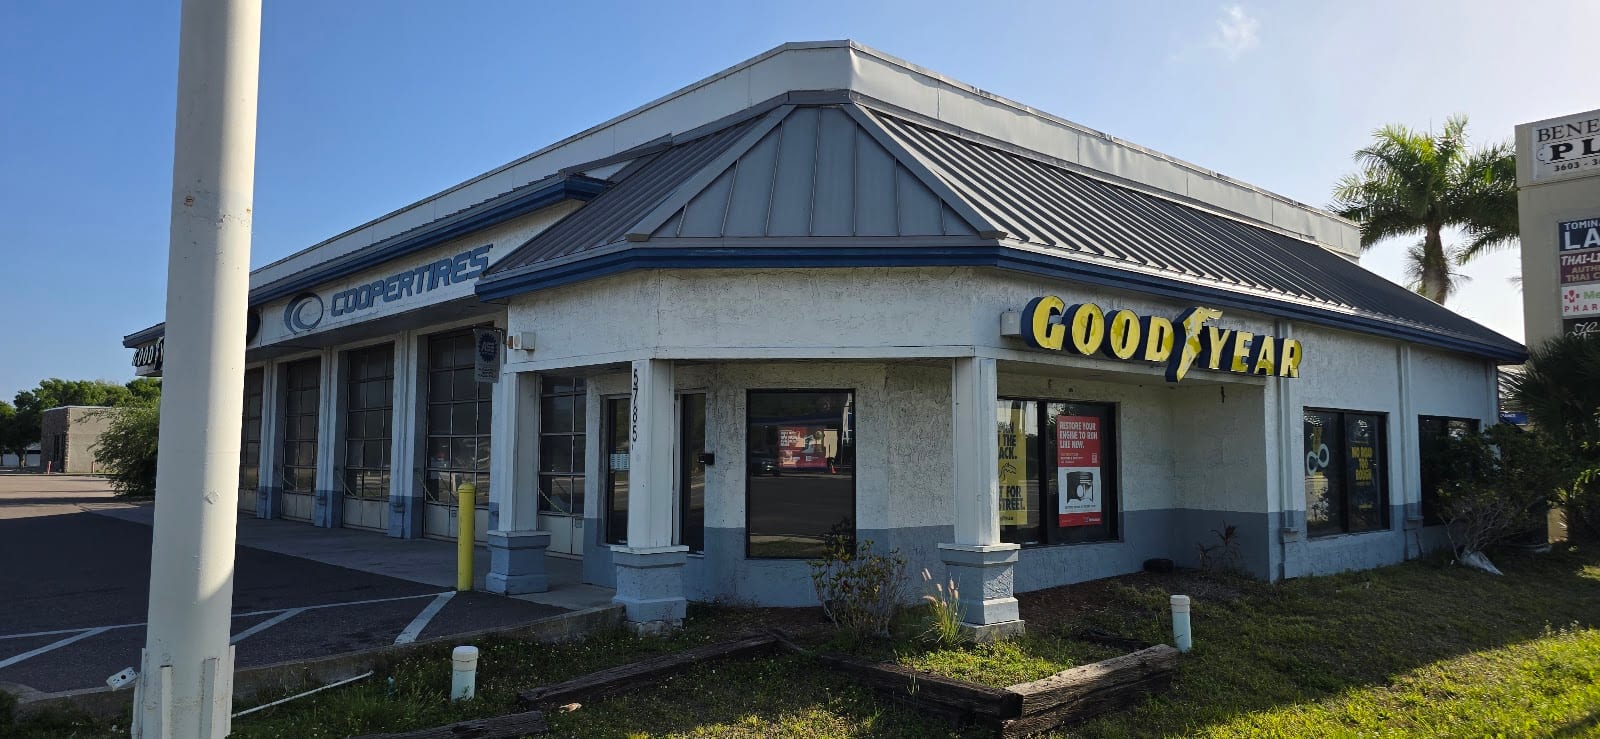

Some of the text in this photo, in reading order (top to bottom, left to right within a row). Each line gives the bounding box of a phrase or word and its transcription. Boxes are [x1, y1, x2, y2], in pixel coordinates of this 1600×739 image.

[1535, 119, 1600, 142] BENE
[1550, 138, 1600, 161] PL
[1553, 161, 1580, 171] 3603
[1592, 158, 1600, 166] 3
[1563, 219, 1600, 230] TOMIN
[1564, 228, 1600, 249] LA
[1561, 252, 1600, 266] THAI-LI
[1565, 273, 1590, 283] THAI
[1584, 291, 1600, 299] Me
[1564, 303, 1598, 312] PHAR
[131, 342, 163, 367] GOOD
[1060, 421, 1096, 430] RESTORE YOUR
[1003, 434, 1016, 446] THE
[1060, 430, 1098, 440] ENGINE TO RUN
[1060, 440, 1085, 449] LIKE NEW.
[999, 446, 1017, 459] ACK.
[1006, 486, 1021, 497] FOR
